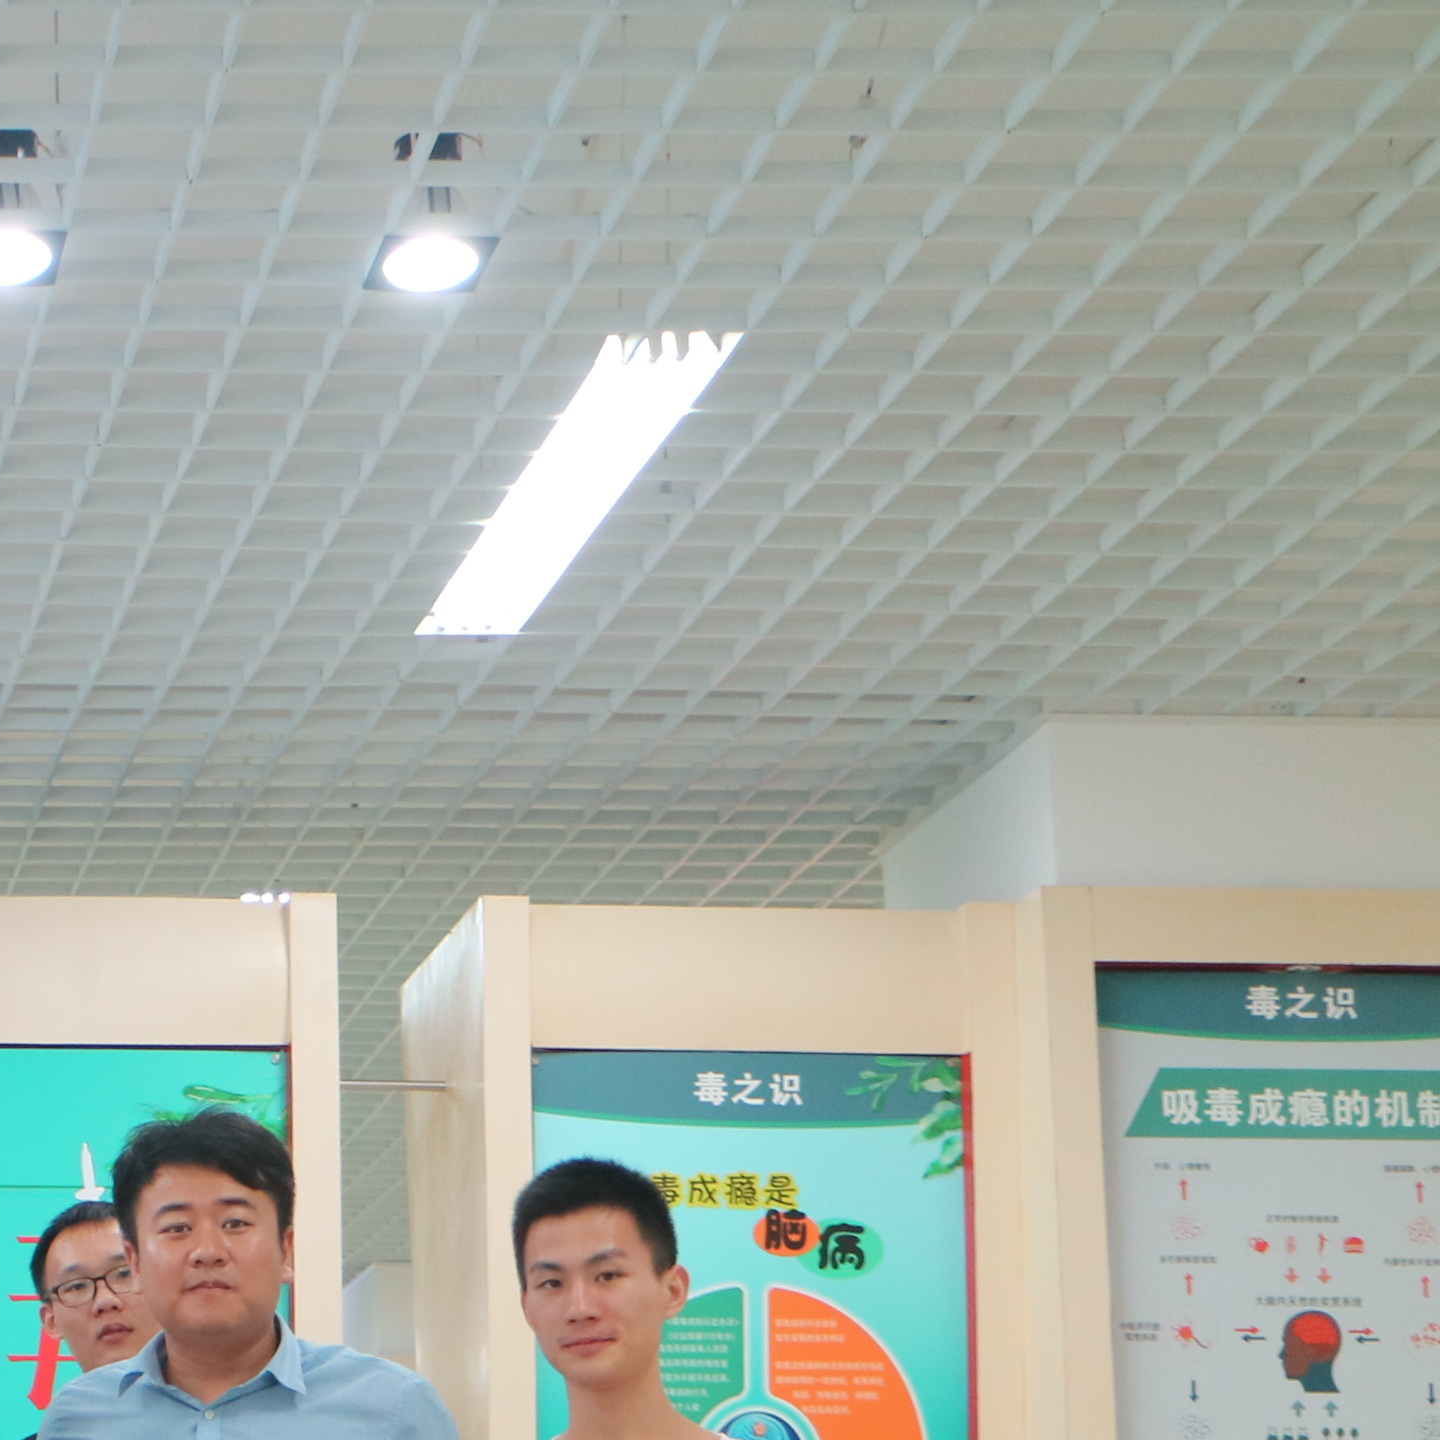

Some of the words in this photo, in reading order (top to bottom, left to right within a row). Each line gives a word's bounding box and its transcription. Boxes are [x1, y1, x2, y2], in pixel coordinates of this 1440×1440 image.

[1246, 985, 1359, 1021] 毒之识
[693, 1071, 804, 1106] 毒之识
[1161, 1087, 1440, 1128] 吸毒成瘾的机制
